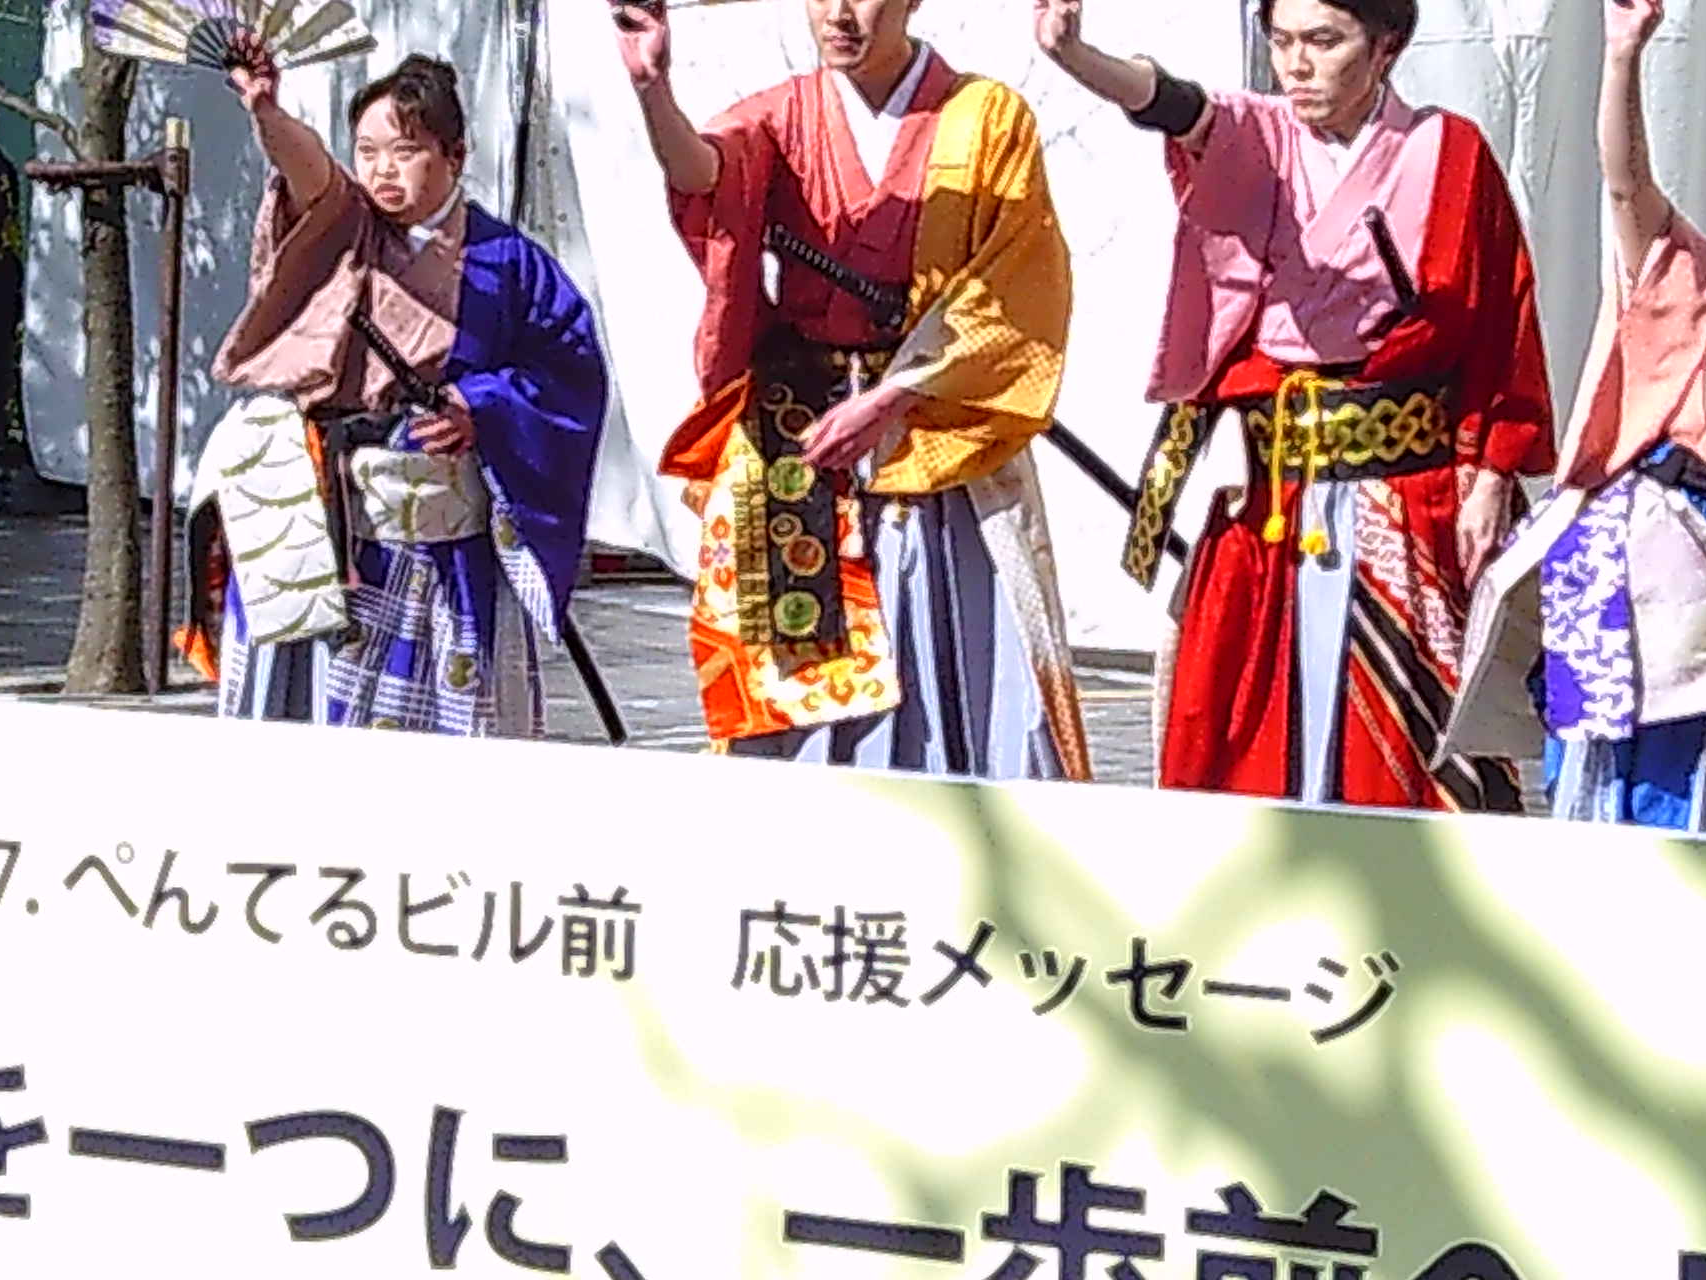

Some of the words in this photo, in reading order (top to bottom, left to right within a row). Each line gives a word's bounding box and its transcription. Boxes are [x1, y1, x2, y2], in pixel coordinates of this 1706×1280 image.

[729, 900, 1401, 1045] 応援メッセージ
